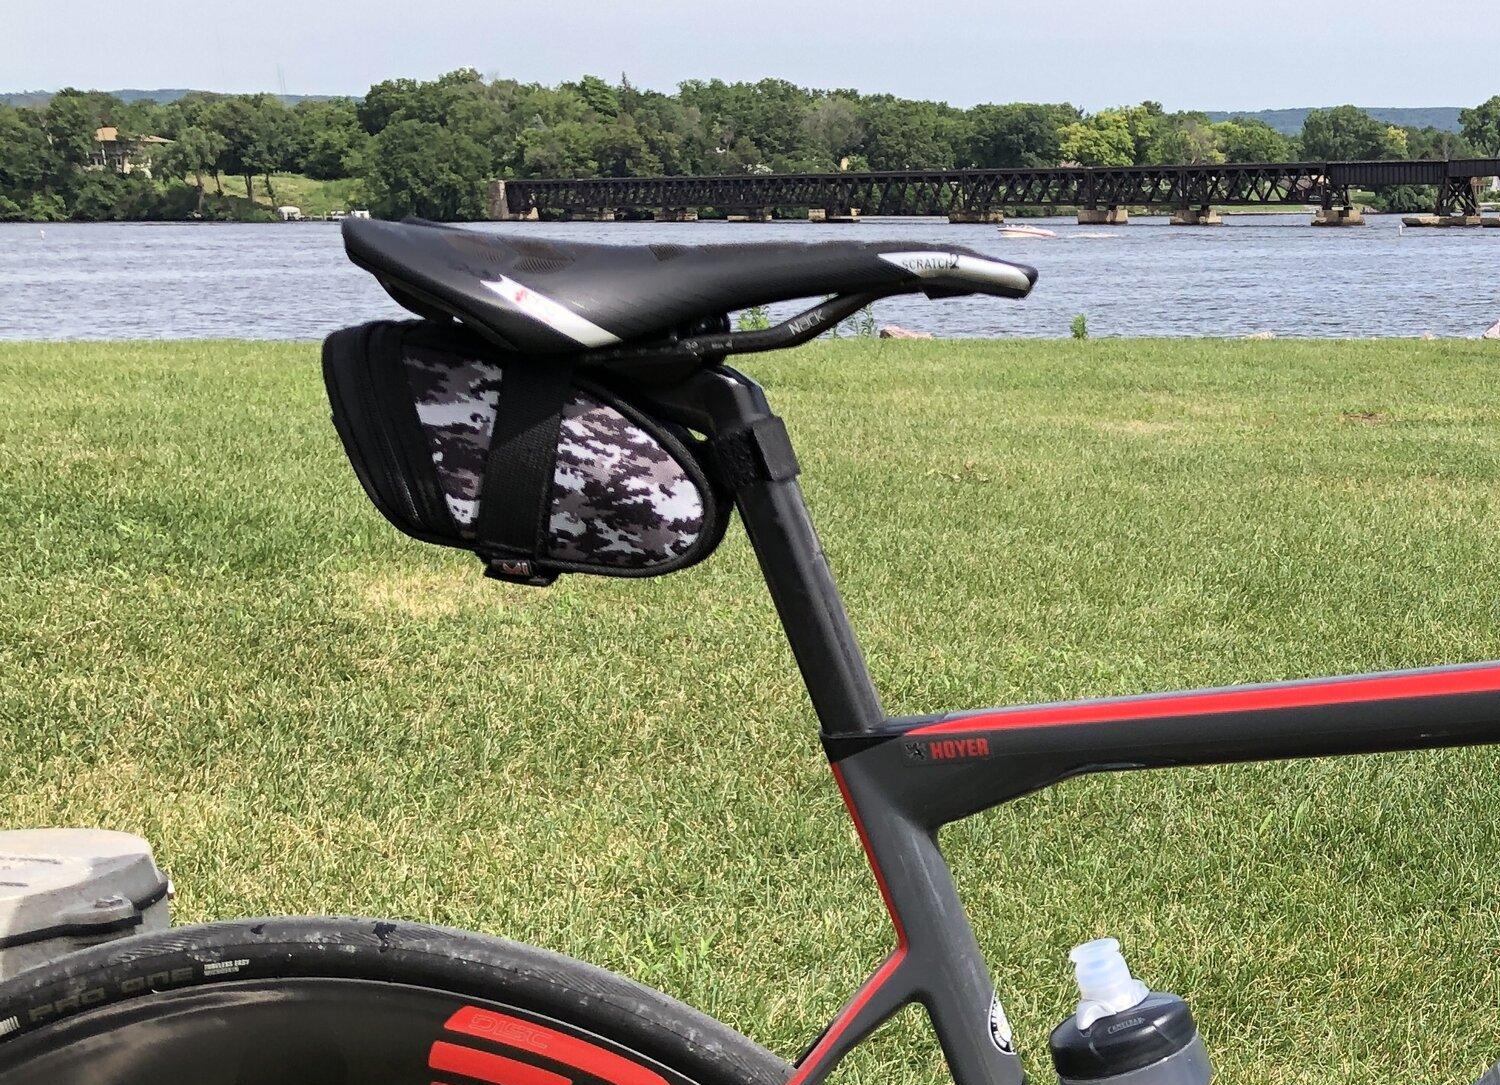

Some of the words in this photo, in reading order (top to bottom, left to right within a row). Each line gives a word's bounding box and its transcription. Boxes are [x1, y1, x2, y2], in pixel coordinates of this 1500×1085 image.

[929, 737, 990, 760] HOYER
[467, 1013, 551, 1050] DISC
[1107, 1016, 1145, 1034] CAMELBAK
